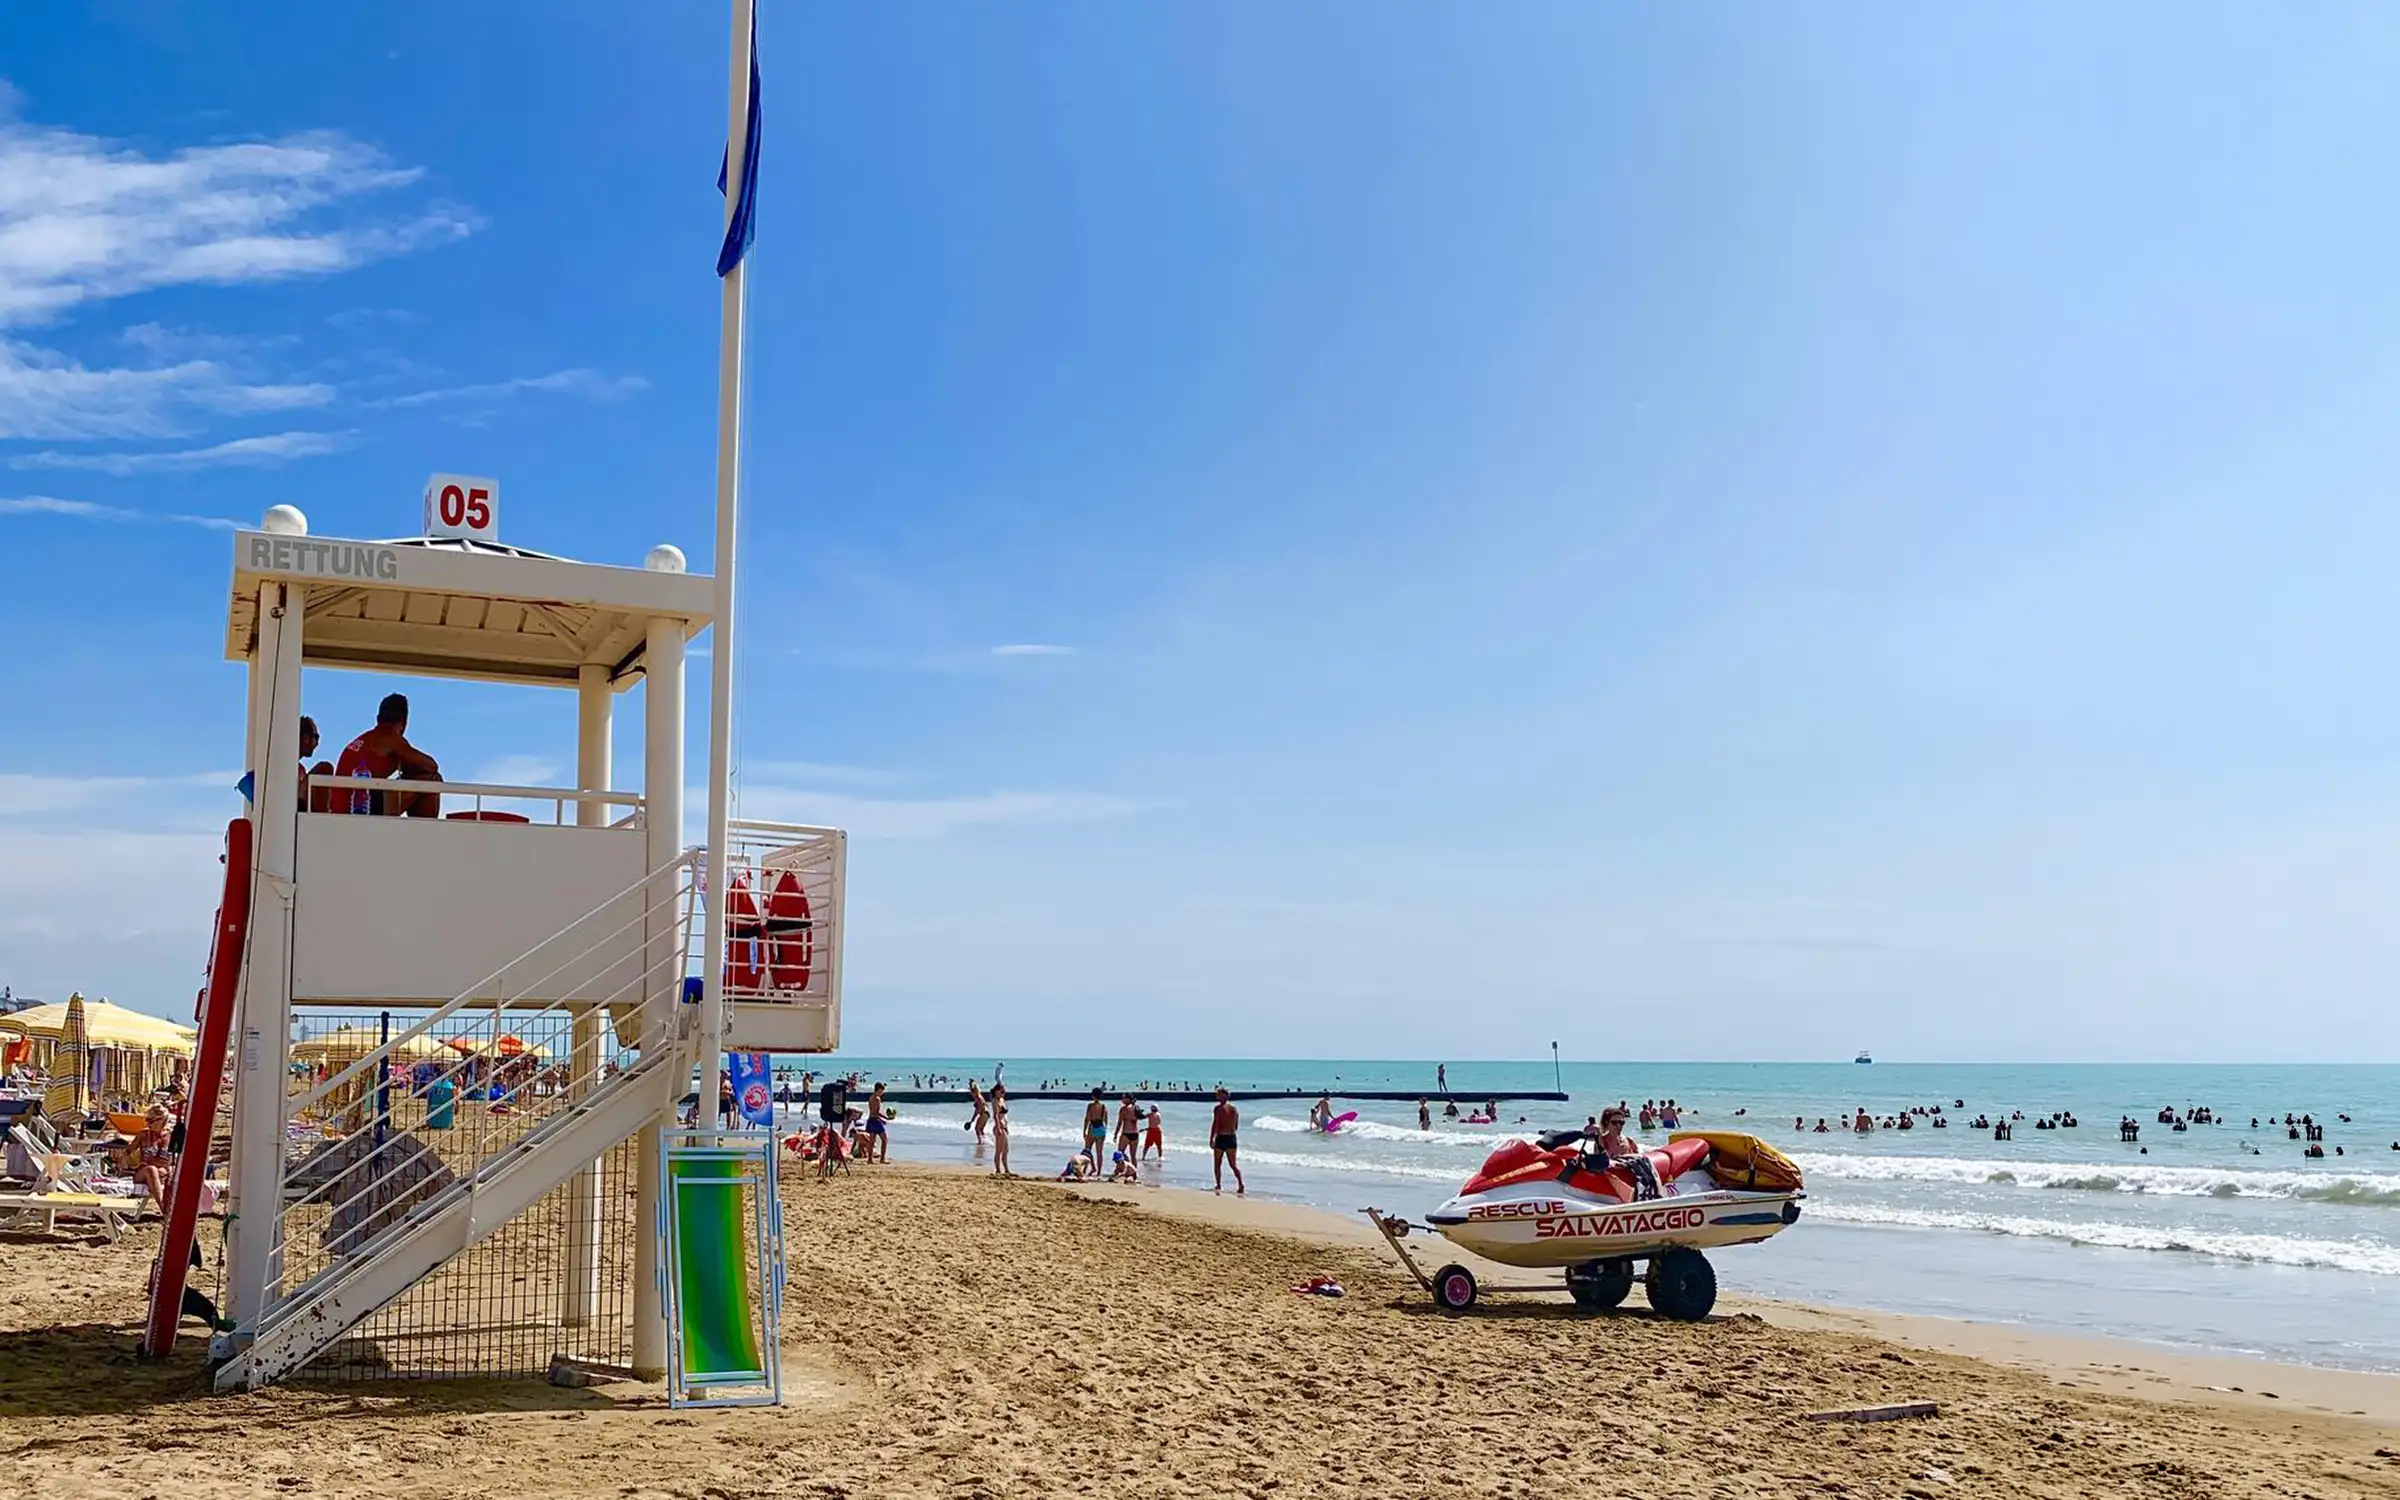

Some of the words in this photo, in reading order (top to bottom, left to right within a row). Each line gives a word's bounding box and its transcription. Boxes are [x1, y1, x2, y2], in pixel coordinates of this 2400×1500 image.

[440, 484, 490, 530] 05
[251, 538, 398, 580] RETTUNG
[1468, 1200, 1567, 1220] RESCUE
[1535, 1208, 1705, 1238] SALVATAGGIO
